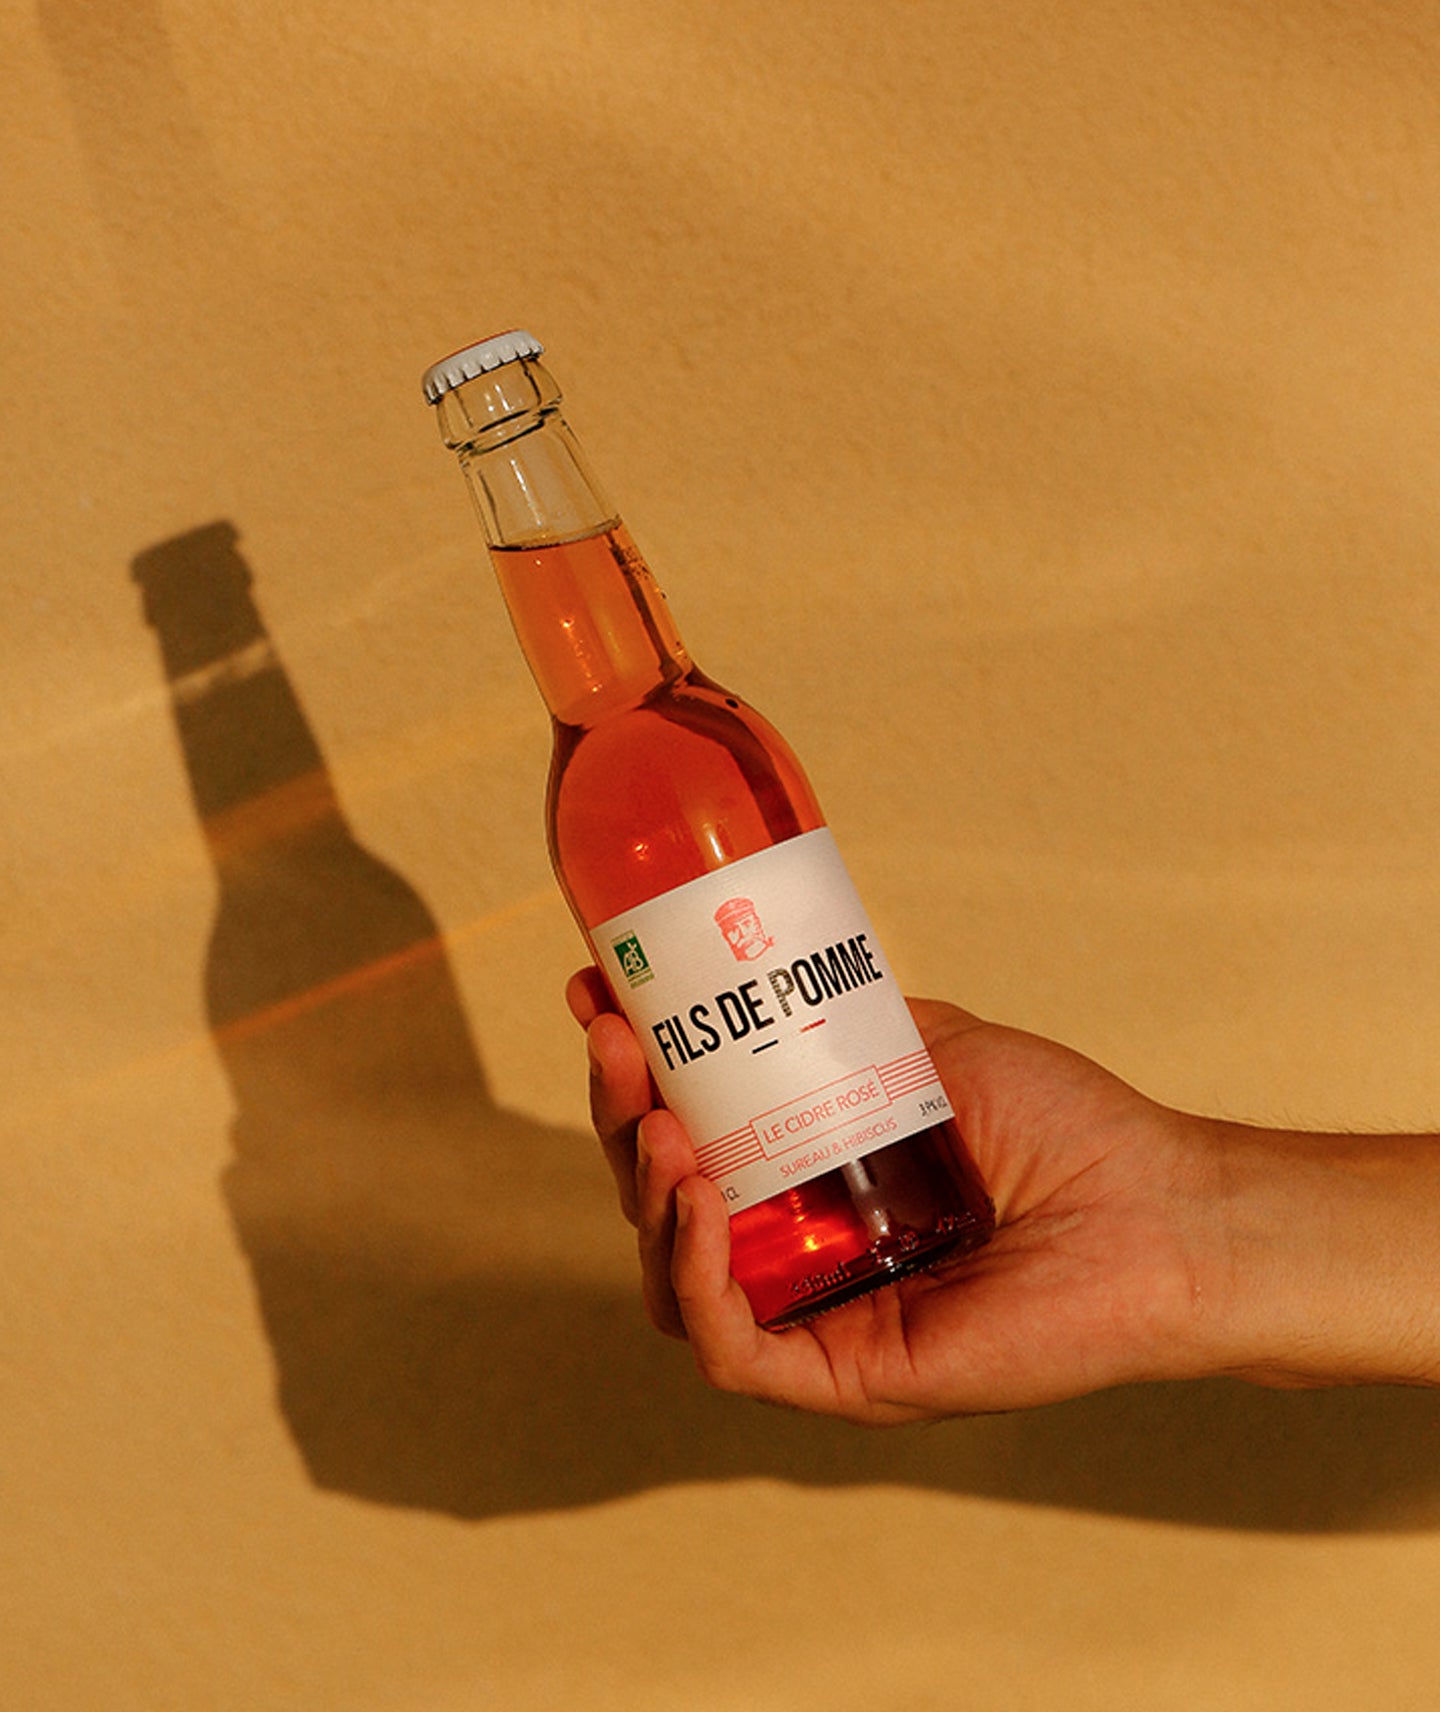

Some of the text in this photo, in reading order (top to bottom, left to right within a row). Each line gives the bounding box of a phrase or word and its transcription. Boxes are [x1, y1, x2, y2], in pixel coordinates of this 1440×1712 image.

[652, 933, 883, 1071] FILS DE POMME
[762, 1080, 880, 1144] LE CIDRE ROSÉ
[779, 1116, 898, 1178] SUREAU & HIBISCUS
